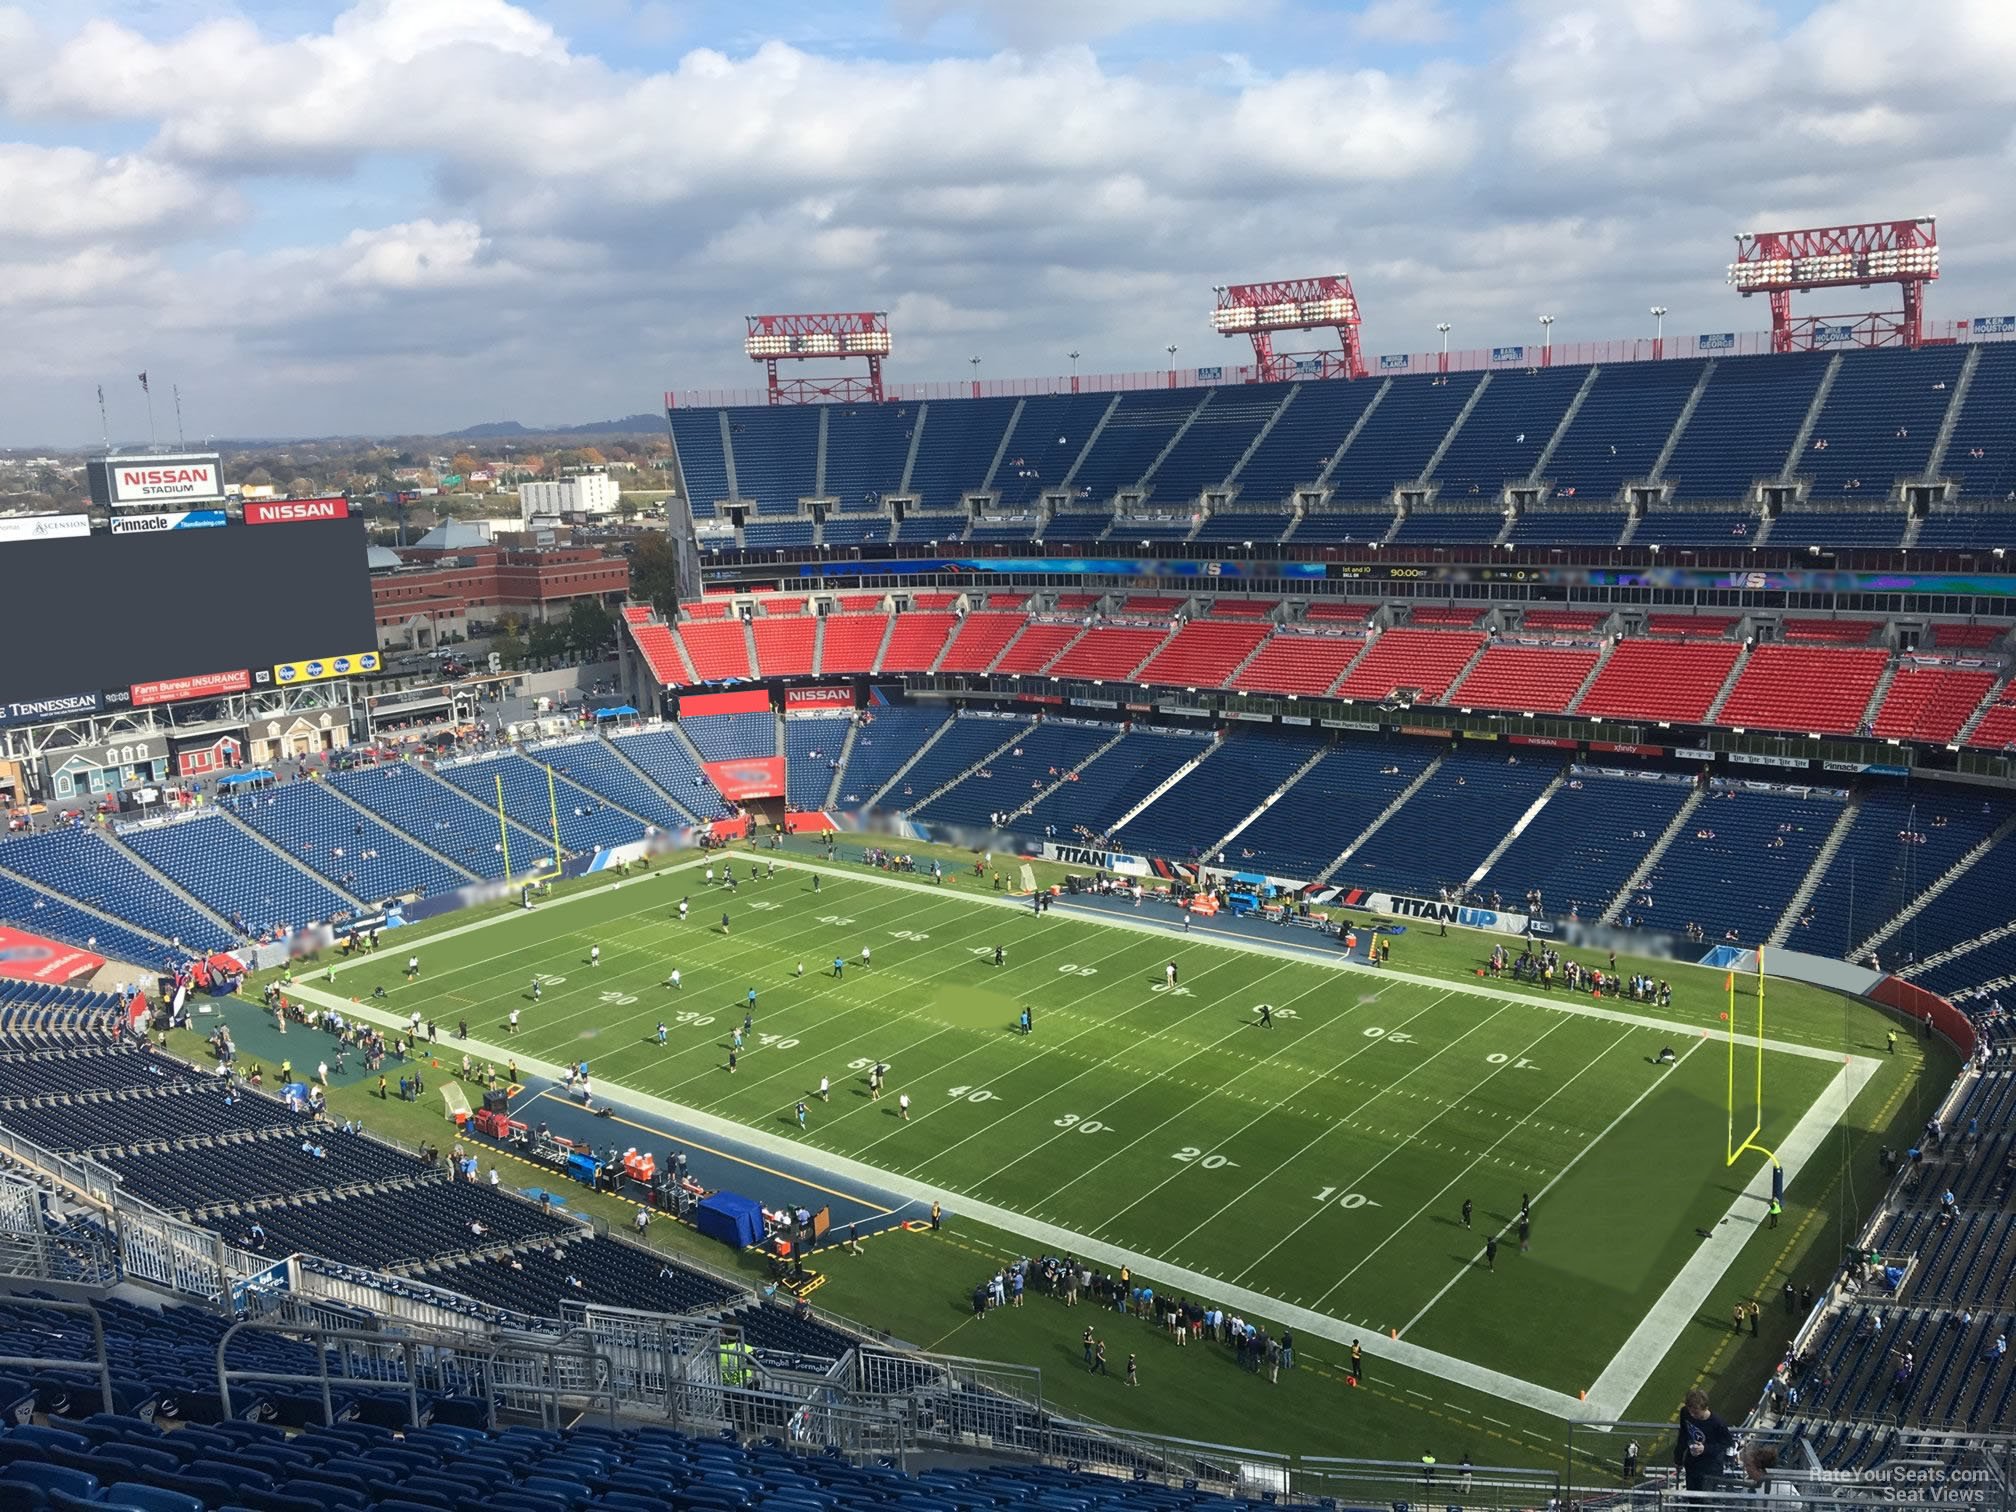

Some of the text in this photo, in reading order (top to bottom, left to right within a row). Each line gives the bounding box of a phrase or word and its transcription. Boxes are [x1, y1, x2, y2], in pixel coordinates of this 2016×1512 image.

[1974, 324, 2014, 333] HOUSTON
[1701, 339, 1734, 348] GEORGE
[1815, 333, 1850, 342] HOLOVAK
[1493, 353, 1522, 361] CAMPBELL
[124, 469, 208, 486] NISSAN
[142, 484, 194, 495] STADIUM
[260, 503, 334, 520] NISSAN
[111, 516, 168, 532] Pinnacle
[1729, 572, 1767, 589] VS
[135, 672, 247, 695] Farm Bureau INSURANCE
[105, 692, 129, 702] 90:00
[789, 689, 850, 701] NISSAN
[9, 694, 97, 717] TENNESSEAN
[1528, 738, 1557, 746] NISSAN
[1614, 744, 1638, 753] xfinity
[1824, 761, 1858, 772] Pinnacle
[1391, 897, 1498, 927] TITANUP
[820, 915, 856, 926] 20
[894, 930, 930, 942] 30
[1058, 964, 1098, 977] 50
[598, 991, 639, 1006] 20
[675, 1011, 716, 1027] 30
[758, 1033, 800, 1050] 40
[1363, 1027, 1412, 1043] 20
[1486, 1053, 1534, 1069] 10
[947, 1085, 993, 1103] 40
[1053, 1113, 1104, 1134] 30
[1170, 1147, 1228, 1169] 20
[1312, 1186, 1368, 1209] 10
[500, 1319, 526, 1331] permobil
[530, 1326, 561, 1337] permobil
[795, 1363, 830, 1374] permobil
